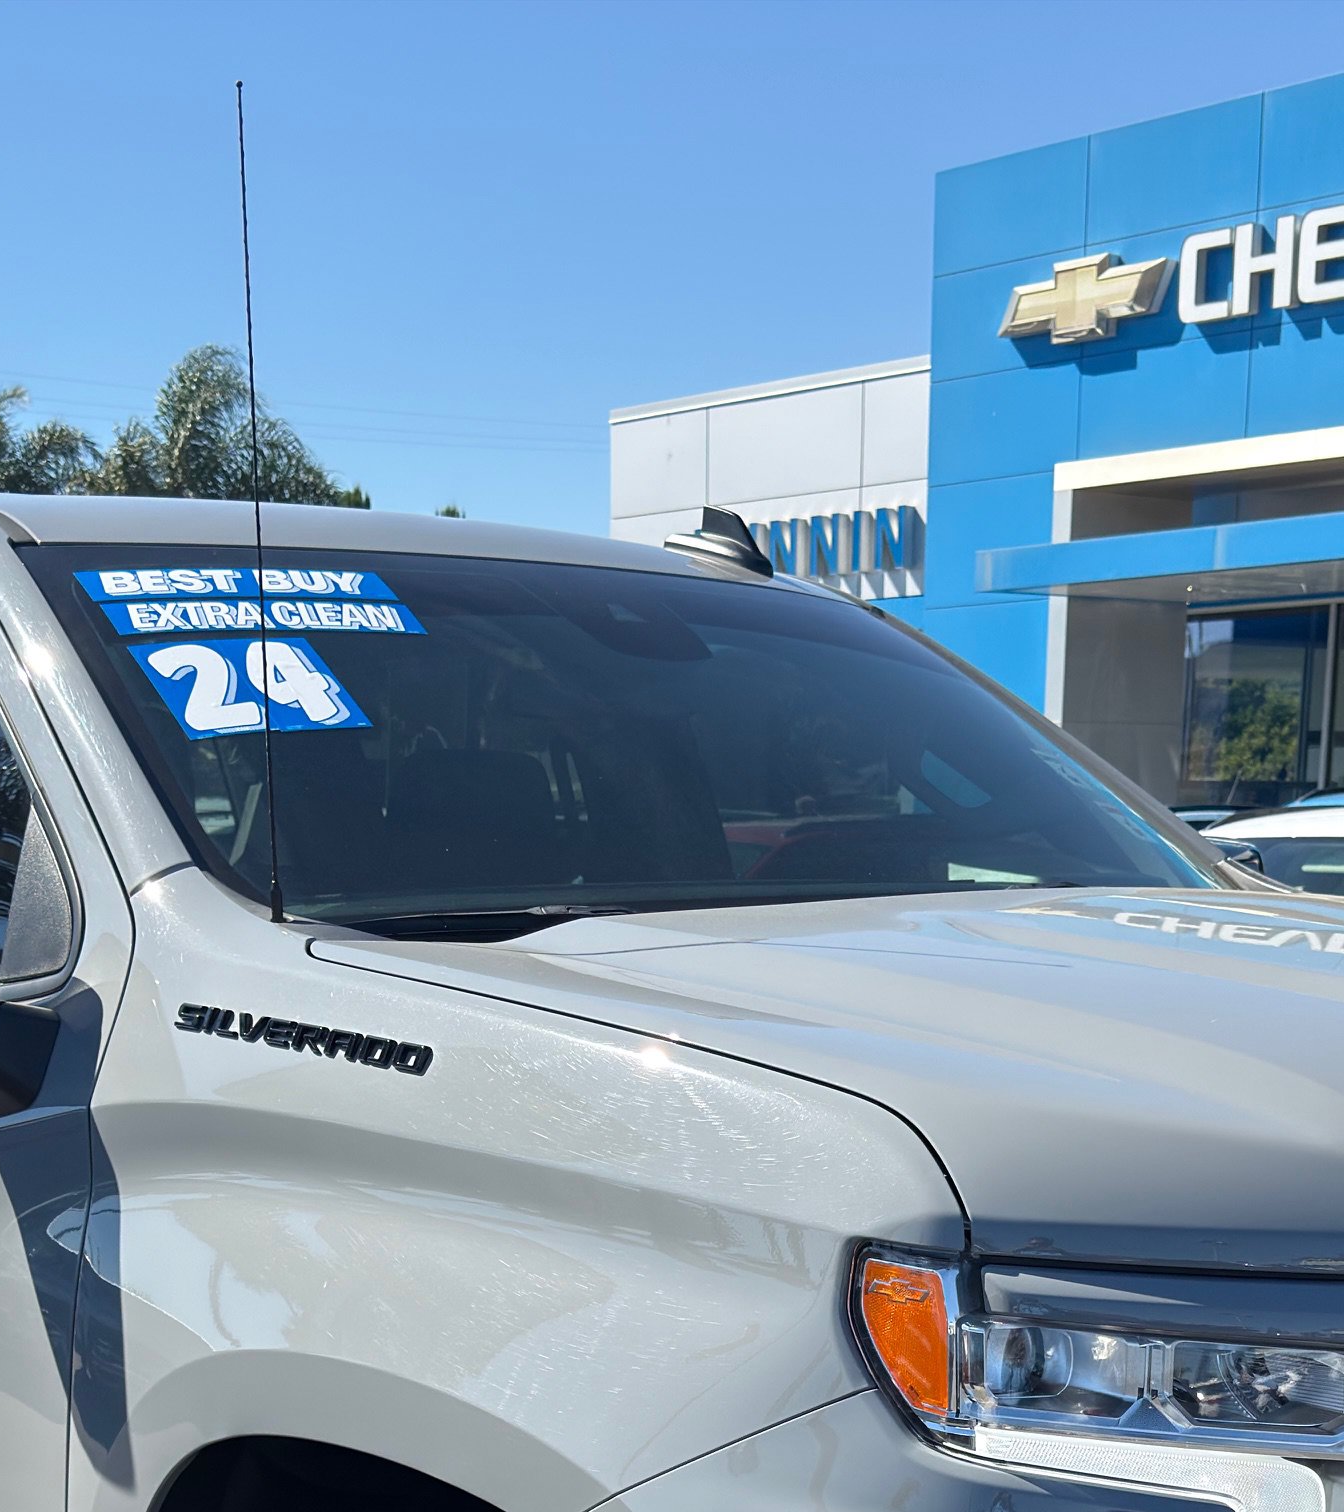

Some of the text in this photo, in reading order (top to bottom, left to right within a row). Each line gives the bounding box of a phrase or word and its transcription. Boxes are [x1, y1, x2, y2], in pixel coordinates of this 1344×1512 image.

[98, 570, 364, 596] BEST BUY
[126, 601, 405, 632] EXTRA CLEAN
[147, 640, 350, 731] 24
[174, 1002, 434, 1077] SILVERADO
